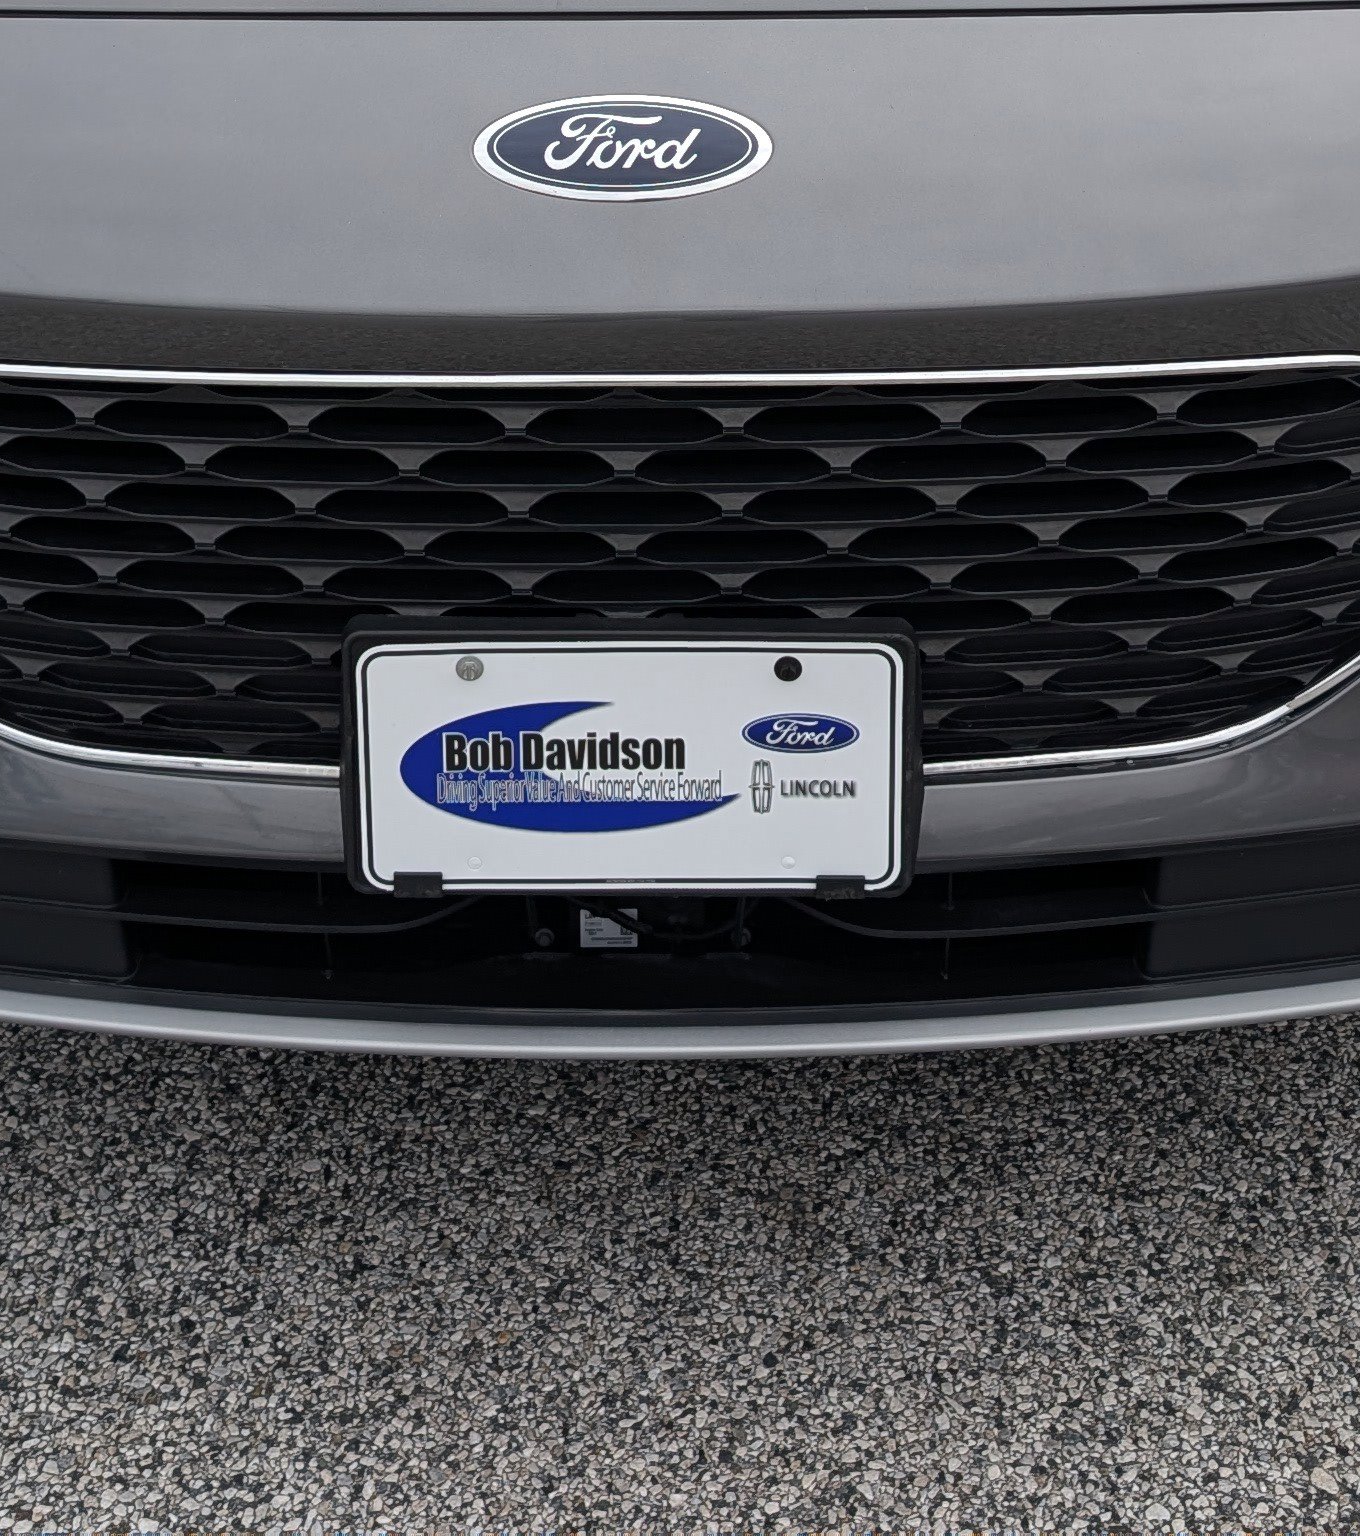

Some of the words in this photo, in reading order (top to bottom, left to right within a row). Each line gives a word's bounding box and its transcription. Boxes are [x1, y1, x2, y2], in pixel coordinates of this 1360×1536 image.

[544, 113, 701, 170] Ford
[442, 731, 514, 773] Bob
[520, 730, 686, 772] Davidson
[765, 718, 836, 745] Ford
[437, 772, 478, 811] Driving
[478, 772, 525, 811] Superior
[523, 771, 557, 803] Value
[557, 771, 581, 802] And
[582, 772, 635, 802] Customer
[636, 771, 676, 802] Service
[677, 770, 723, 802] Forward
[780, 779, 857, 798] LINCOLN
